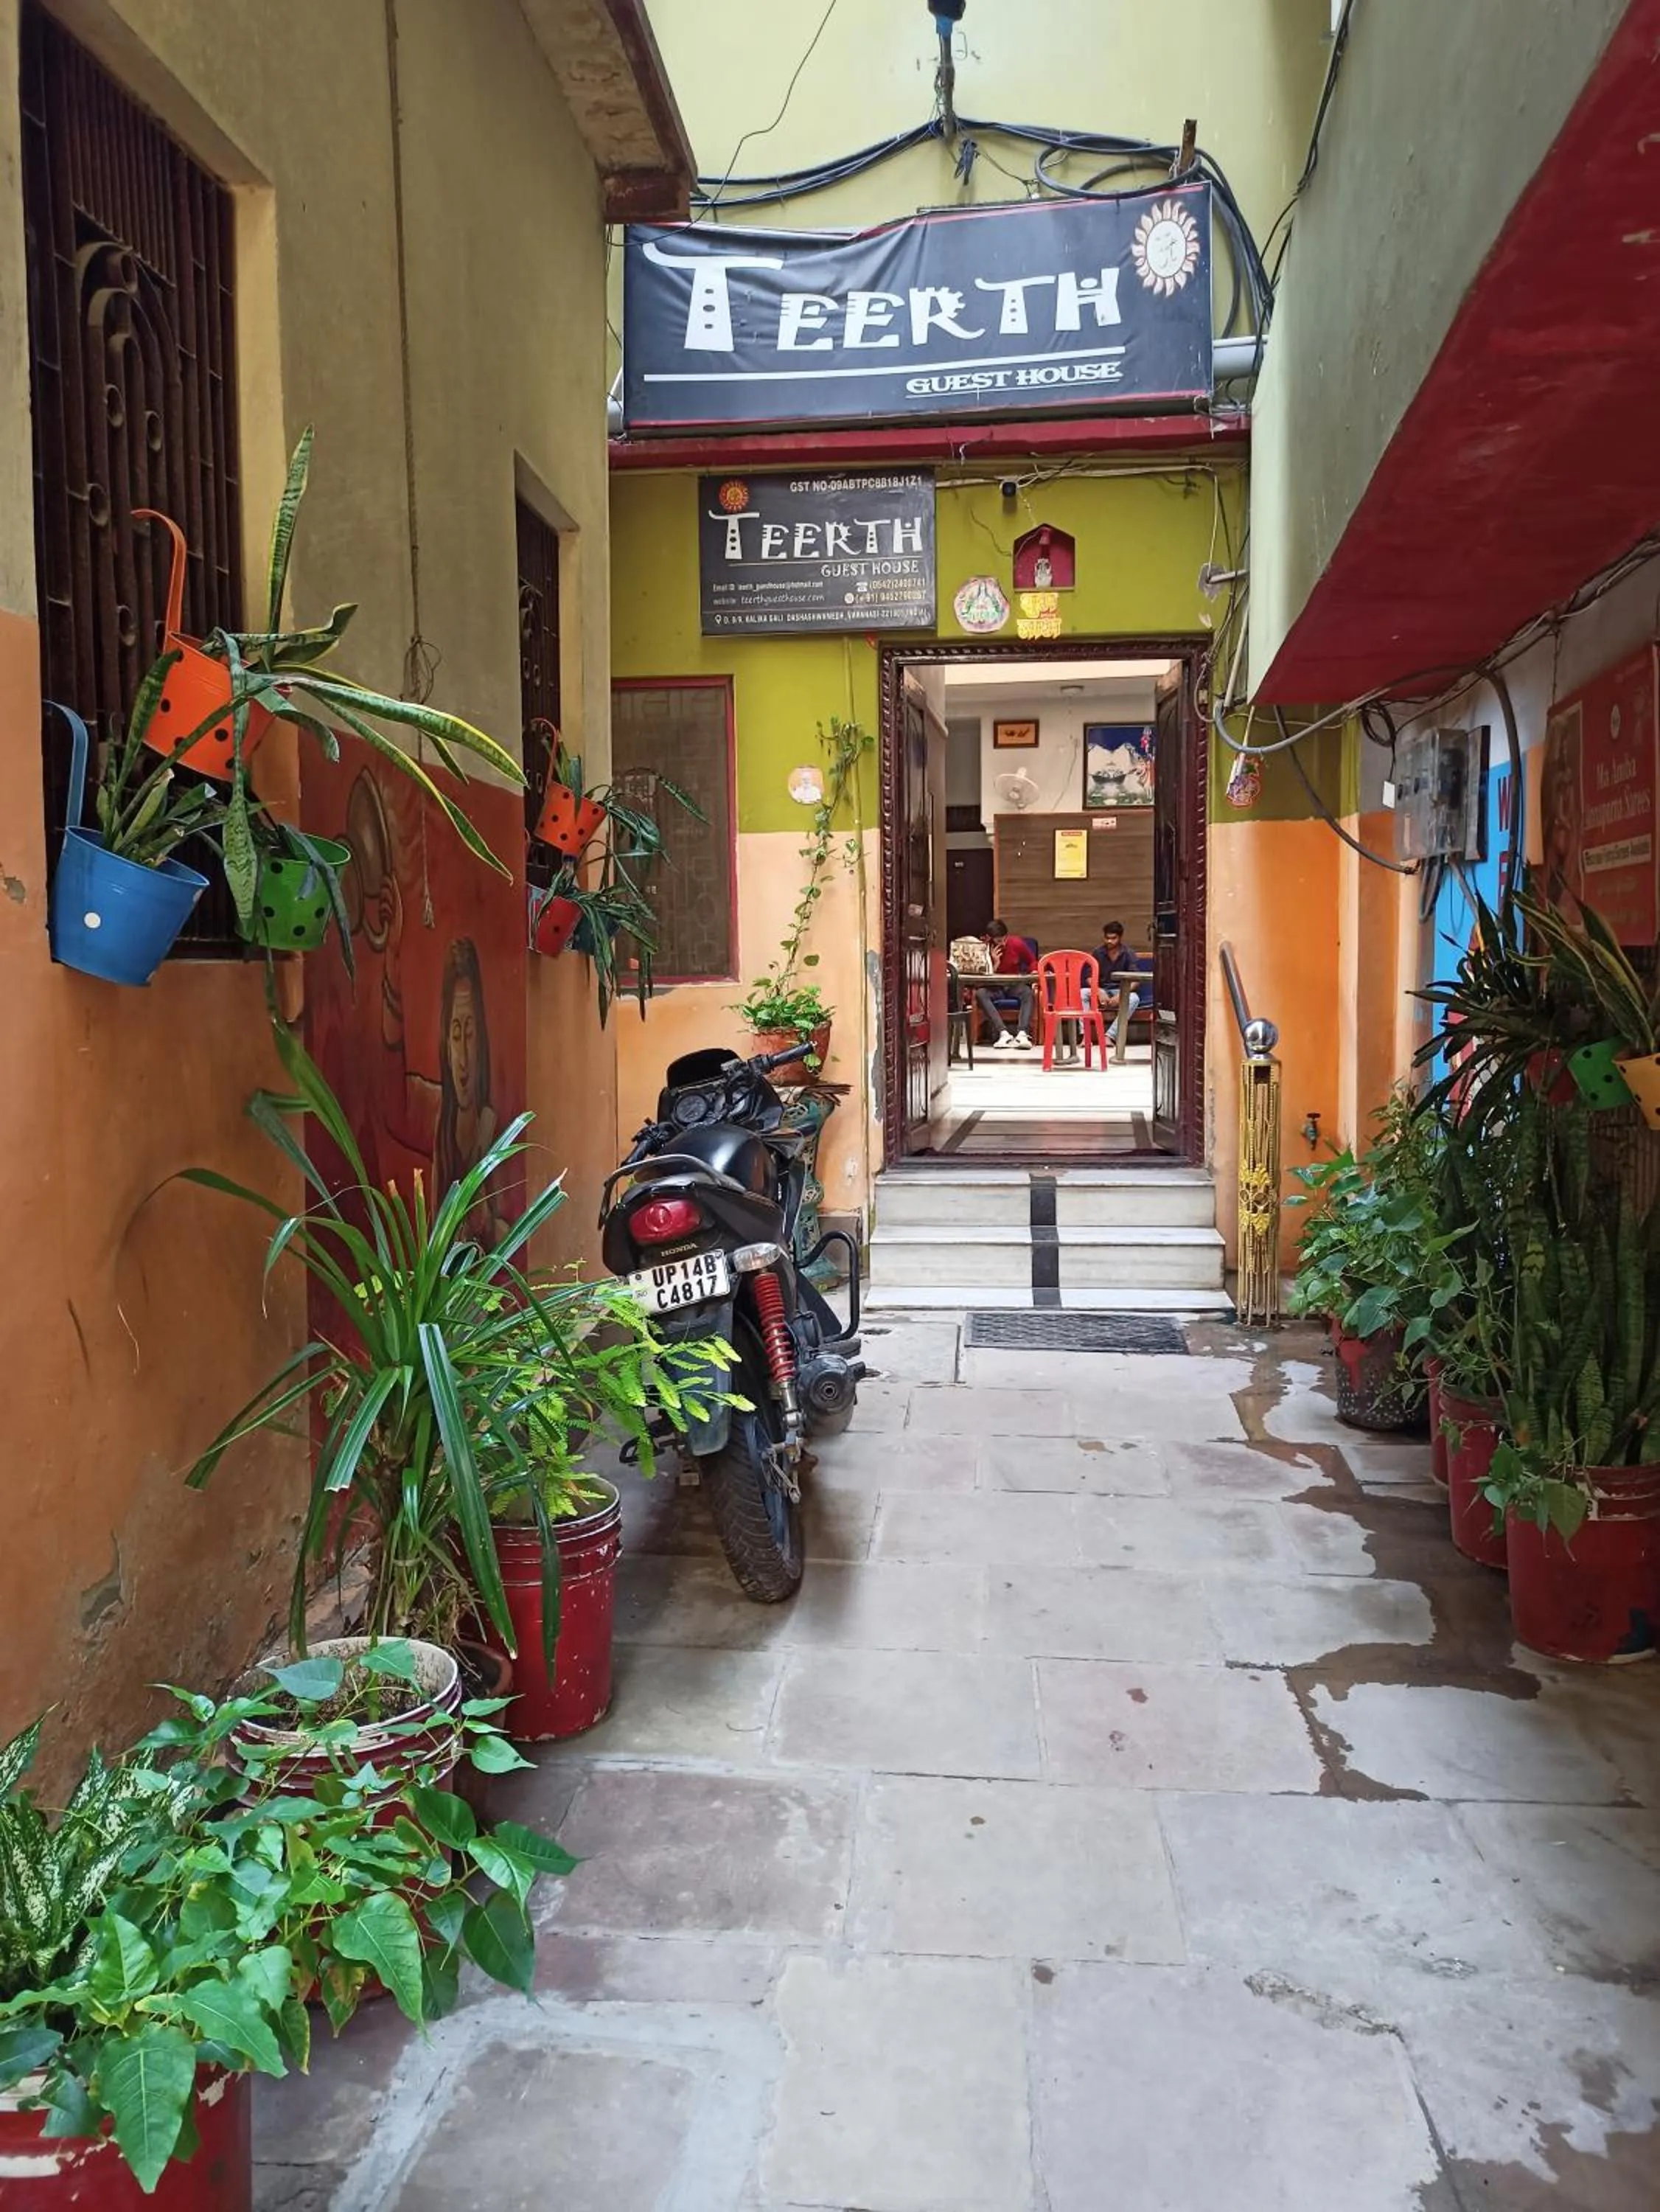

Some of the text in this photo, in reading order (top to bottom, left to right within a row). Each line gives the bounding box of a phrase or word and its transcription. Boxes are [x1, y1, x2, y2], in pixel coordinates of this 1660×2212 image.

[642, 243, 1123, 352] TEERTH
[906, 362, 1123, 394] GUEST HOUSE
[790, 481, 810, 493] GST
[708, 510, 923, 560] TEERTH
[820, 560, 920, 577] GUEST HOUSE
[660, 1242, 698, 1257] HONDA
[657, 1276, 717, 1309] C4817
